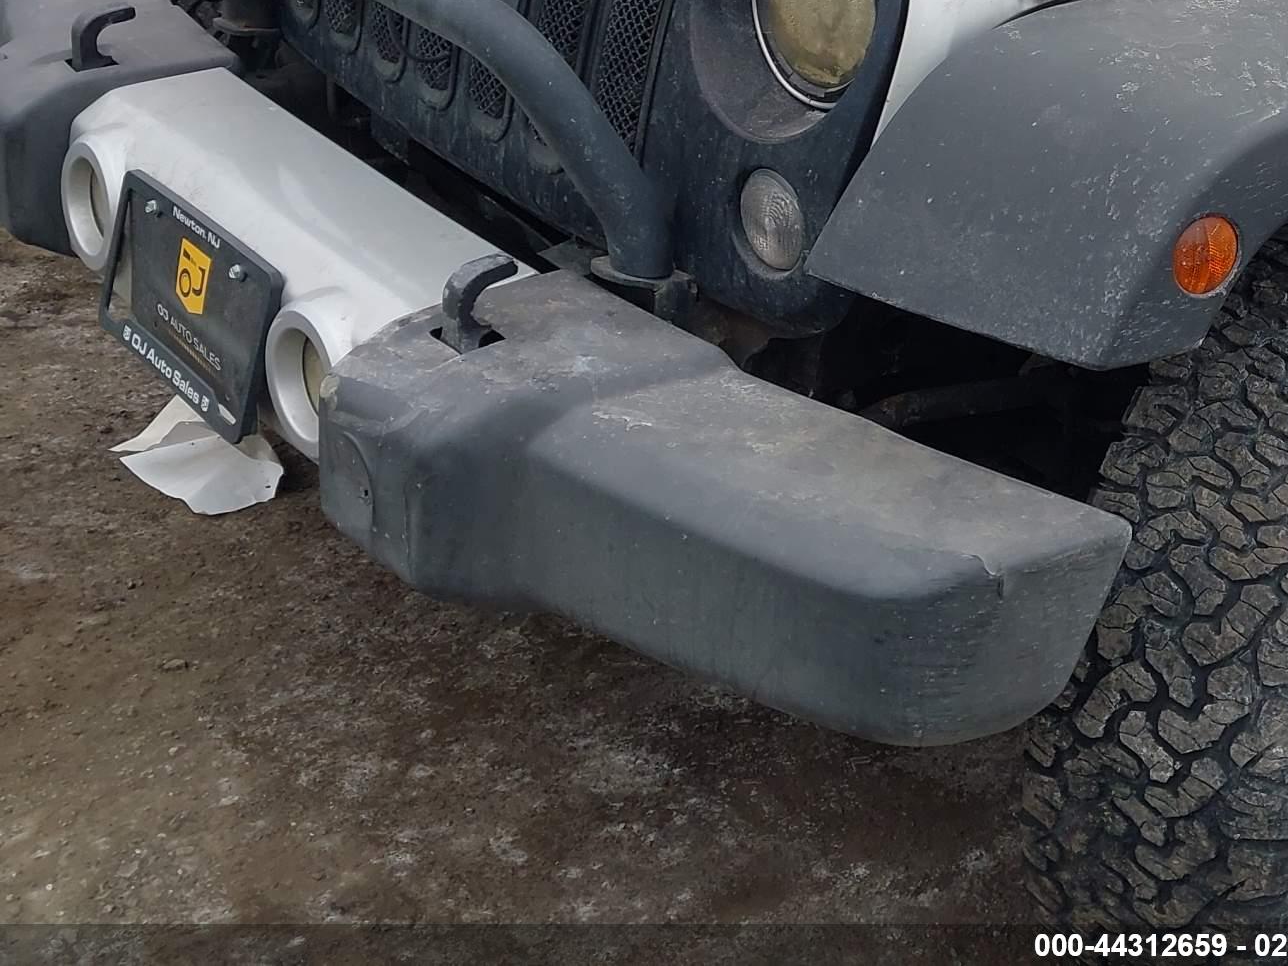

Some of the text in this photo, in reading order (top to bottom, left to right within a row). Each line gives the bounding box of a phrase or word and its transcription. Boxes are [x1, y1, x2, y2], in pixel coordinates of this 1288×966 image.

[207, 231, 221, 249] NJ
[131, 333, 148, 356] OJ
[146, 347, 173, 379] Auto
[172, 369, 200, 405] Sales
[170, 315, 193, 344] AUTO
[193, 337, 221, 371] SALES
